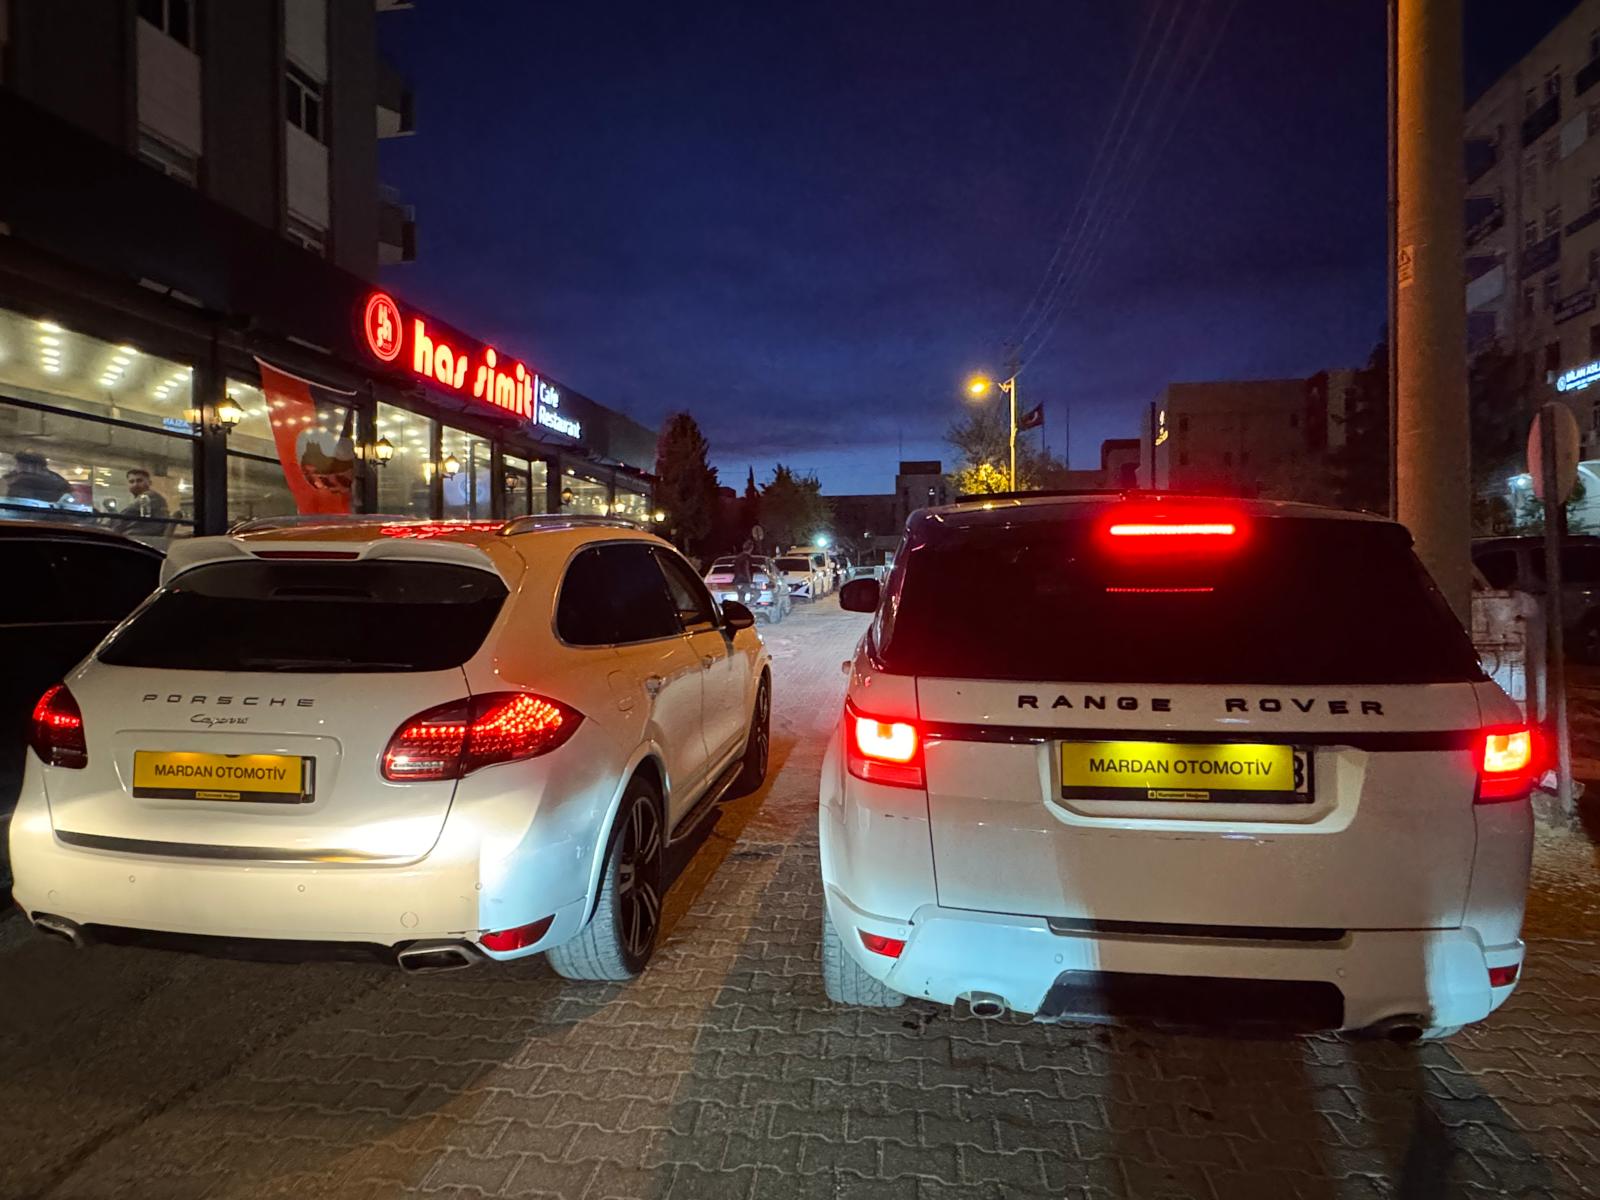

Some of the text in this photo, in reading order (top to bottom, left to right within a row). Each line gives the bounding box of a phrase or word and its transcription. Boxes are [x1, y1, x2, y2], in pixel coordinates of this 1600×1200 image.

[414, 318, 467, 389] has
[474, 348, 533, 418] simit
[142, 694, 315, 708] PORSCHE
[1017, 694, 1384, 716] RANGE ROVER
[154, 764, 287, 781] MARDAN OTOMOTİV
[1089, 758, 1273, 776] MARDAN OTOMOTİV
